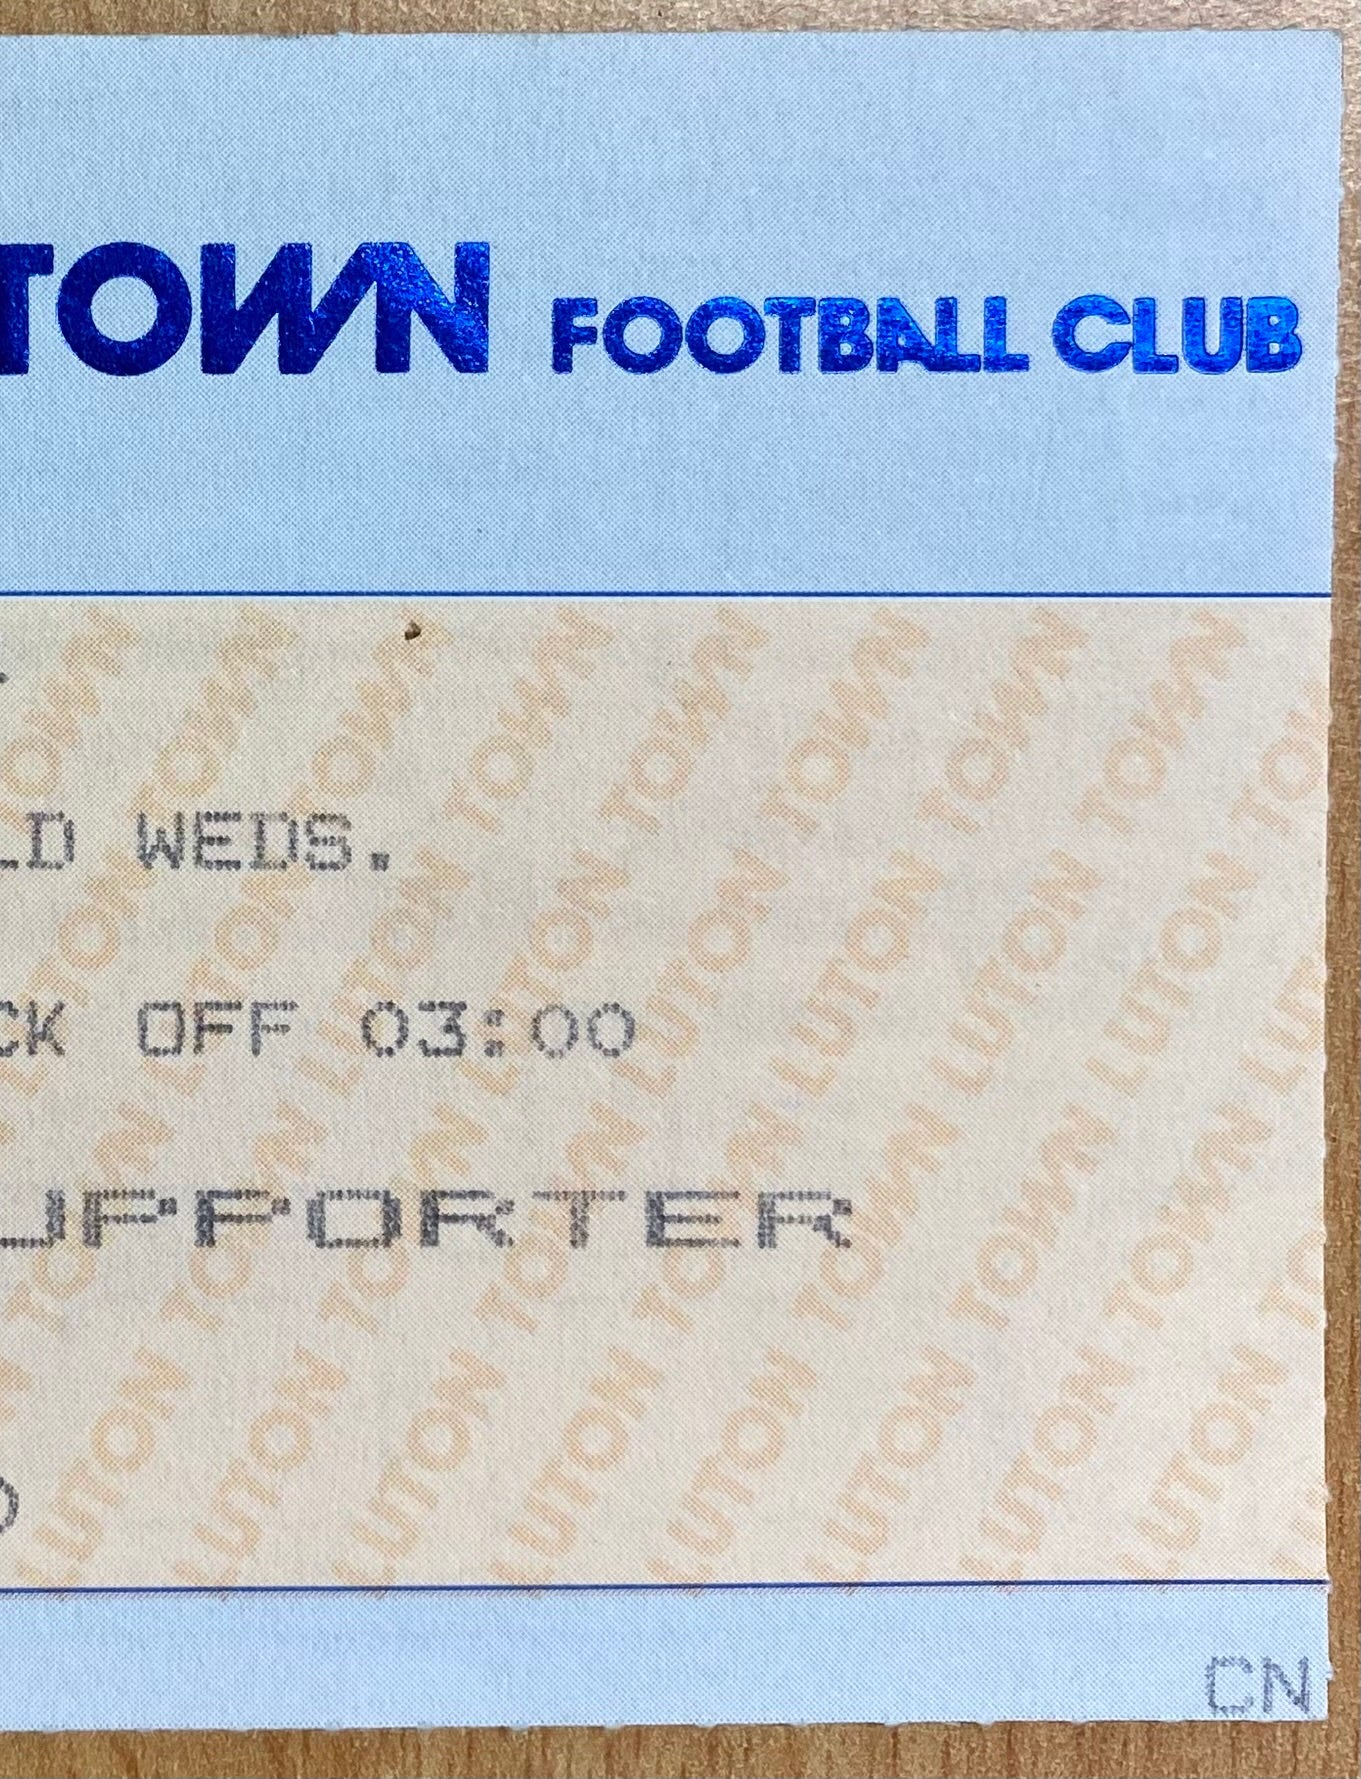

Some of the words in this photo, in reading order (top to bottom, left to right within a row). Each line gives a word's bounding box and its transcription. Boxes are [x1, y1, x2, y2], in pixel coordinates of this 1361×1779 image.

[551, 293, 1030, 374] FOOTBALL
[1051, 291, 1305, 374] CLUB
[136, 811, 390, 872] WEDS.
[137, 1000, 298, 1057] OFF
[361, 1000, 636, 1058] 03:00
[1205, 1656, 1312, 1716] CN
